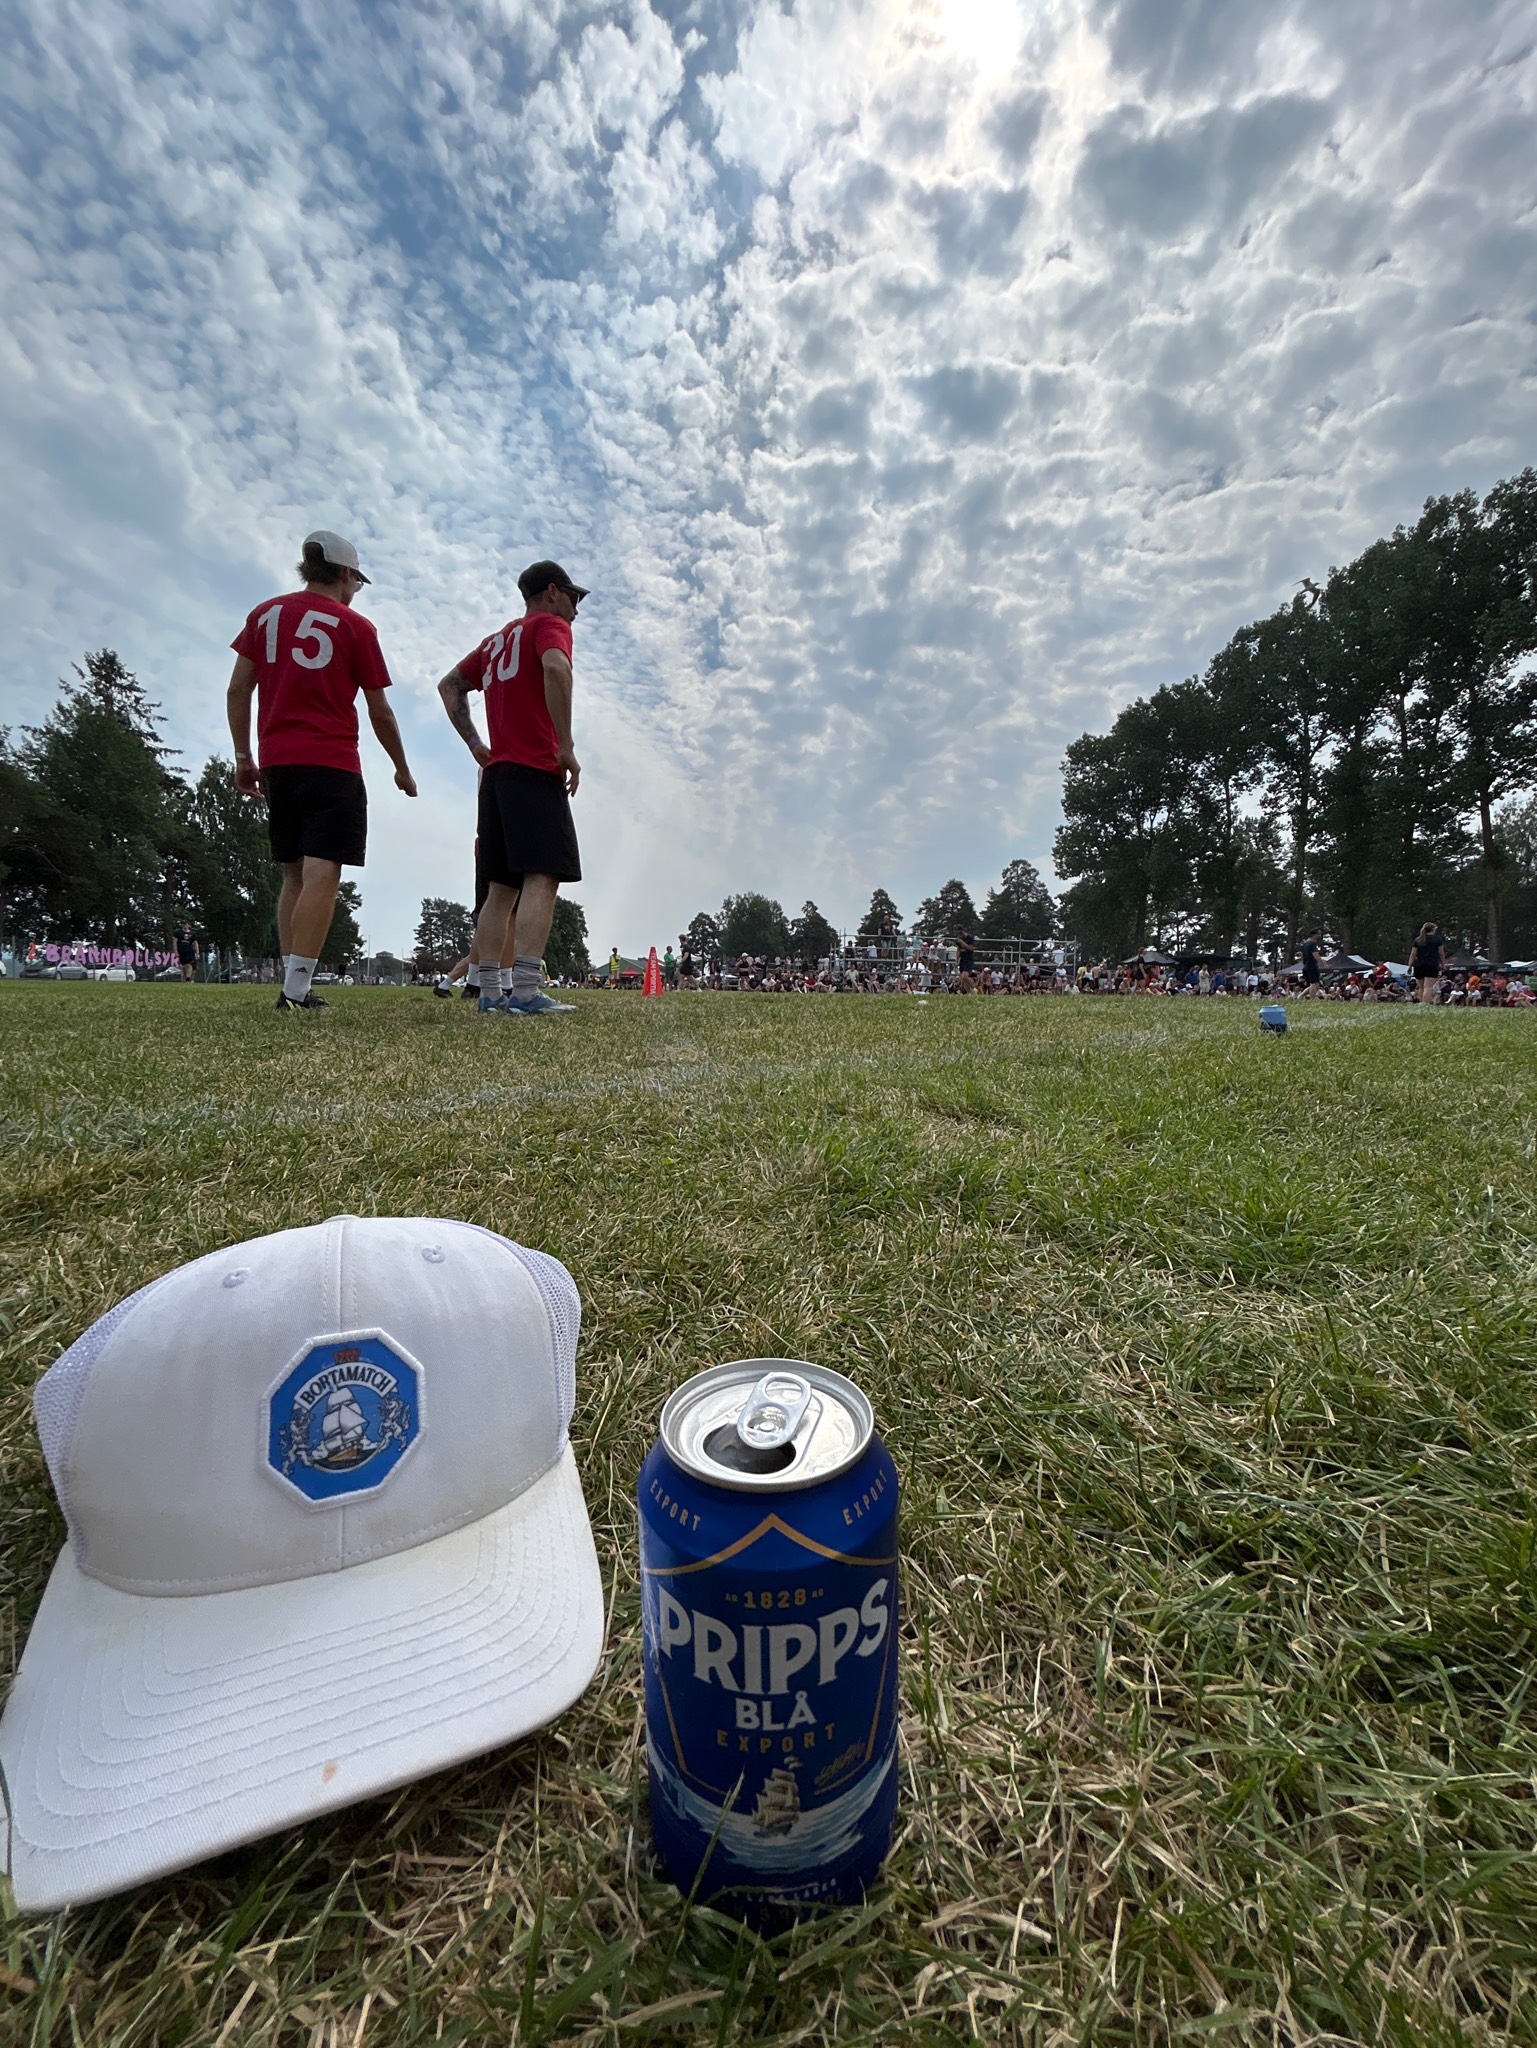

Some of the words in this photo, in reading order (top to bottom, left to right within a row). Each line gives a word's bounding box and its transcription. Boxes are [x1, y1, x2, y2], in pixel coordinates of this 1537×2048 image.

[257, 604, 341, 670] 15
[482, 625, 524, 690] 20
[300, 1365, 392, 1406] BORTAMATCH
[649, 1478, 702, 1532] EXPORT
[841, 1468, 888, 1526] EXPORT
[743, 1587, 807, 1610] 1828
[657, 1577, 889, 1695] PRIPPS
[735, 1690, 817, 1731] BLÅ
[716, 1722, 836, 1754] EXPORT
